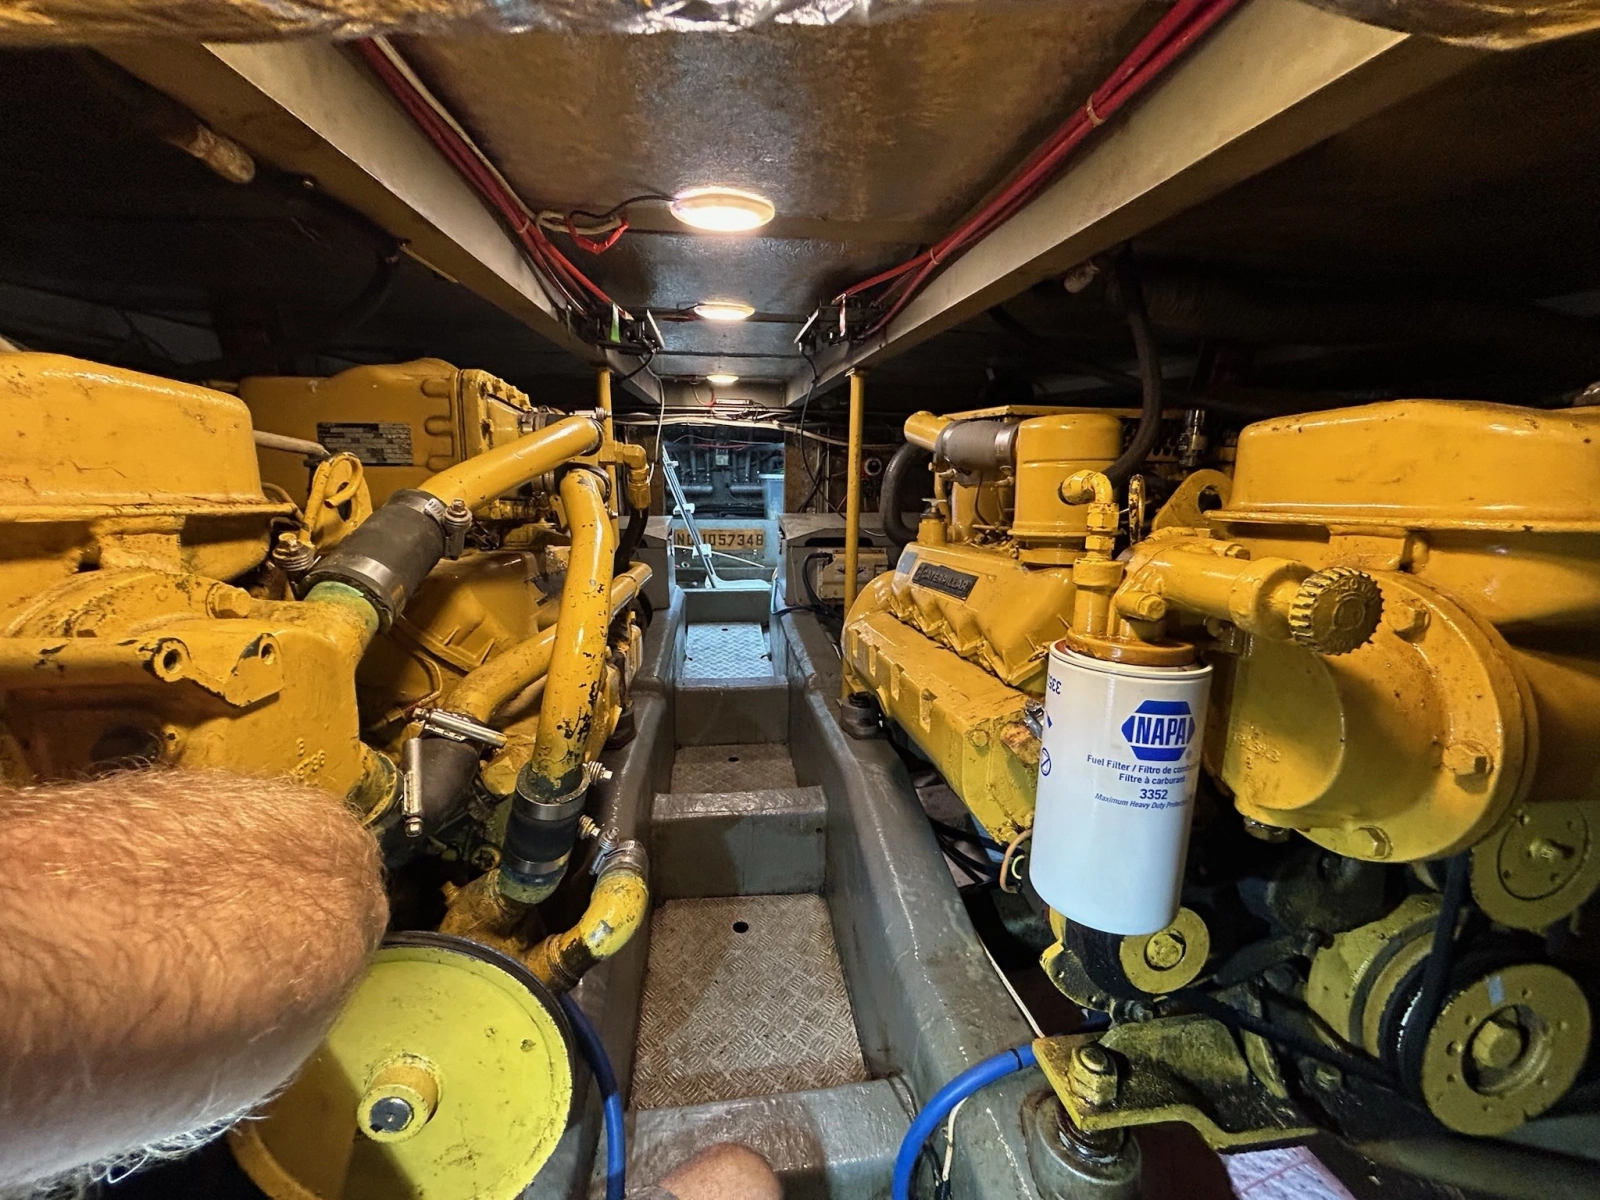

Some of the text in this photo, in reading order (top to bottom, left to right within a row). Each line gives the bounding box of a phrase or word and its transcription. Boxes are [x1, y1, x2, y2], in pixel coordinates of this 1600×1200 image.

[1135, 716, 1187, 746] NAPA
[1087, 754, 1105, 766] Fuel
[1106, 760, 1131, 772] Filter
[1131, 764, 1137, 772] /
[1138, 765, 1160, 774] Filtro
[1162, 766, 1172, 774] de
[1119, 773, 1142, 784] Filtre
[1144, 776, 1150, 784] à
[1095, 792, 1129, 807] Maximum
[1129, 801, 1151, 810] Heavy
[1151, 802, 1166, 810] Duty
[1139, 789, 1168, 800] 3352
